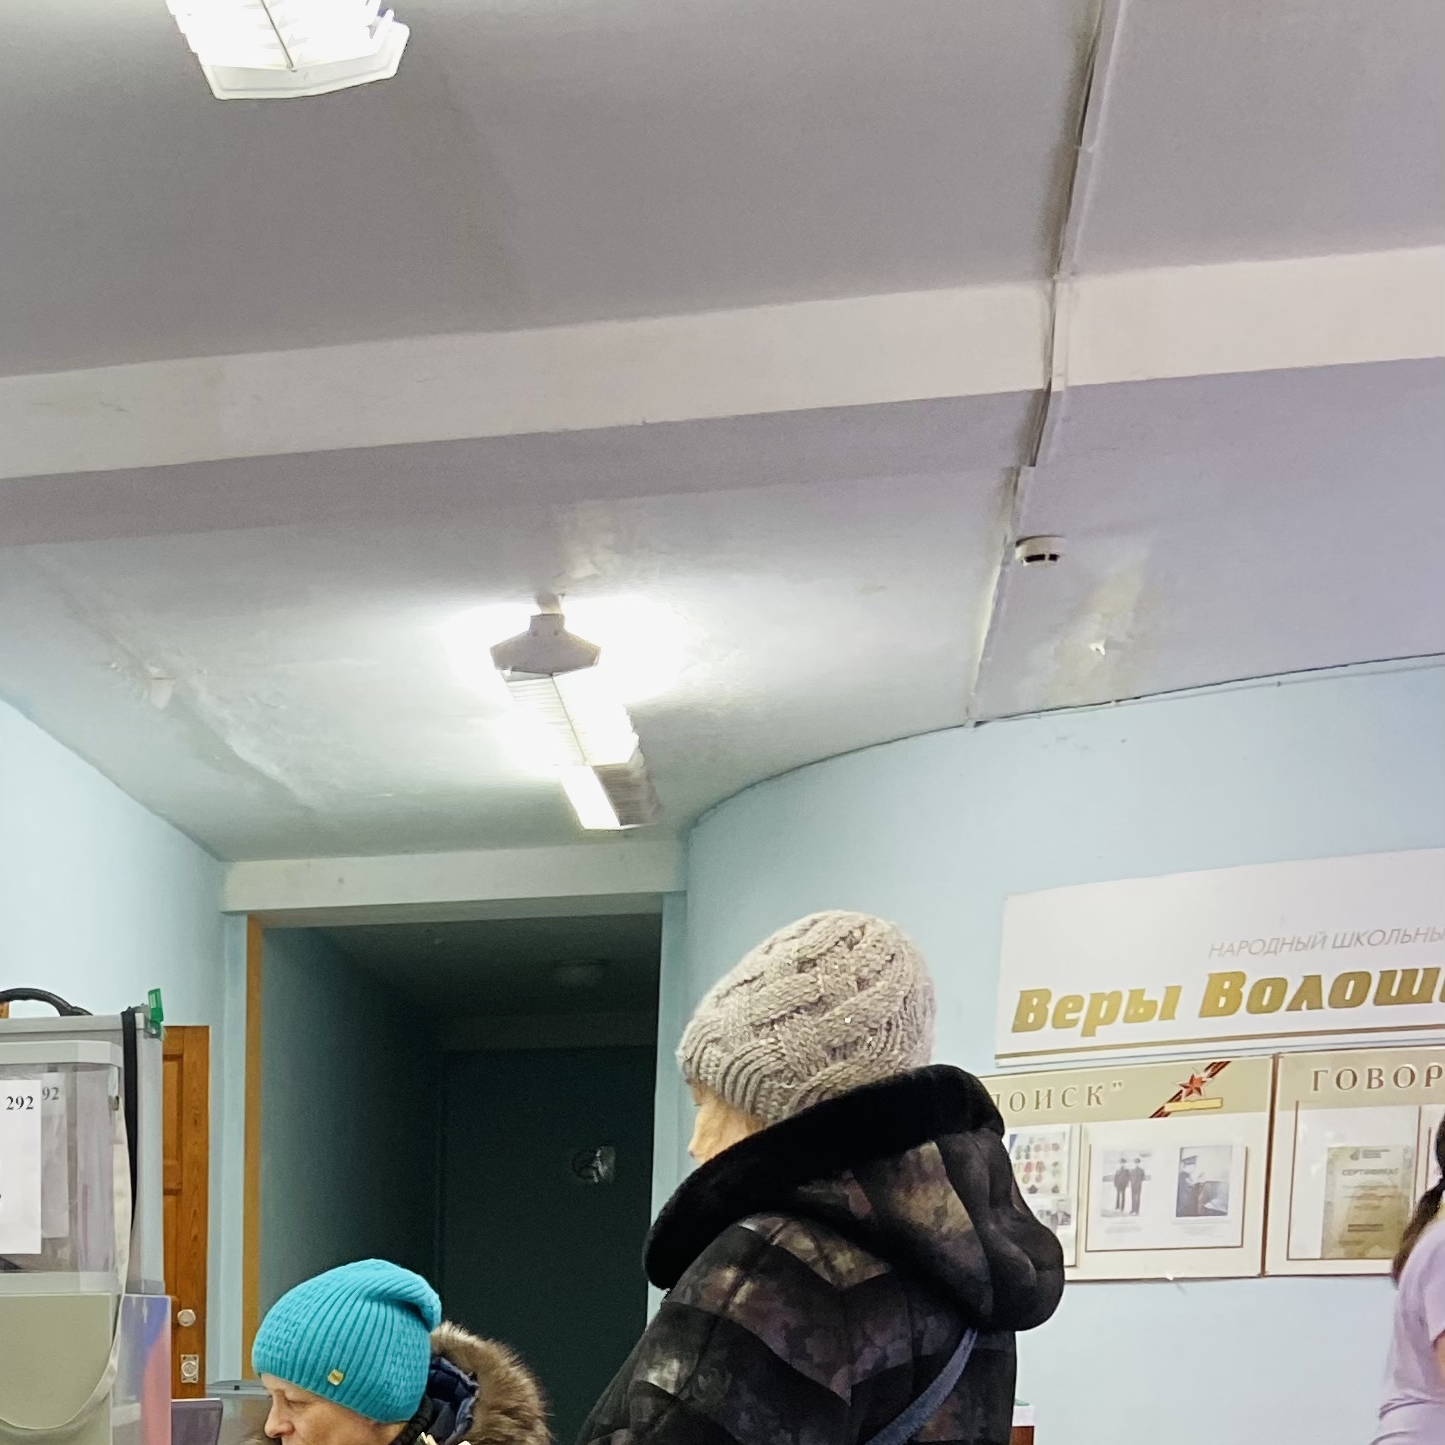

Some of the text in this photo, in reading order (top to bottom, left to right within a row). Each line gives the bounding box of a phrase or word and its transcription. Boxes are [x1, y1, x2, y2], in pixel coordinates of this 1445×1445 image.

[1208, 931, 1328, 959] НАРОДНЫЙ
[1011, 966, 1445, 1037] Веры Волош
[5, 1096, 35, 1111] 292
[41, 1087, 60, 1101] 92
